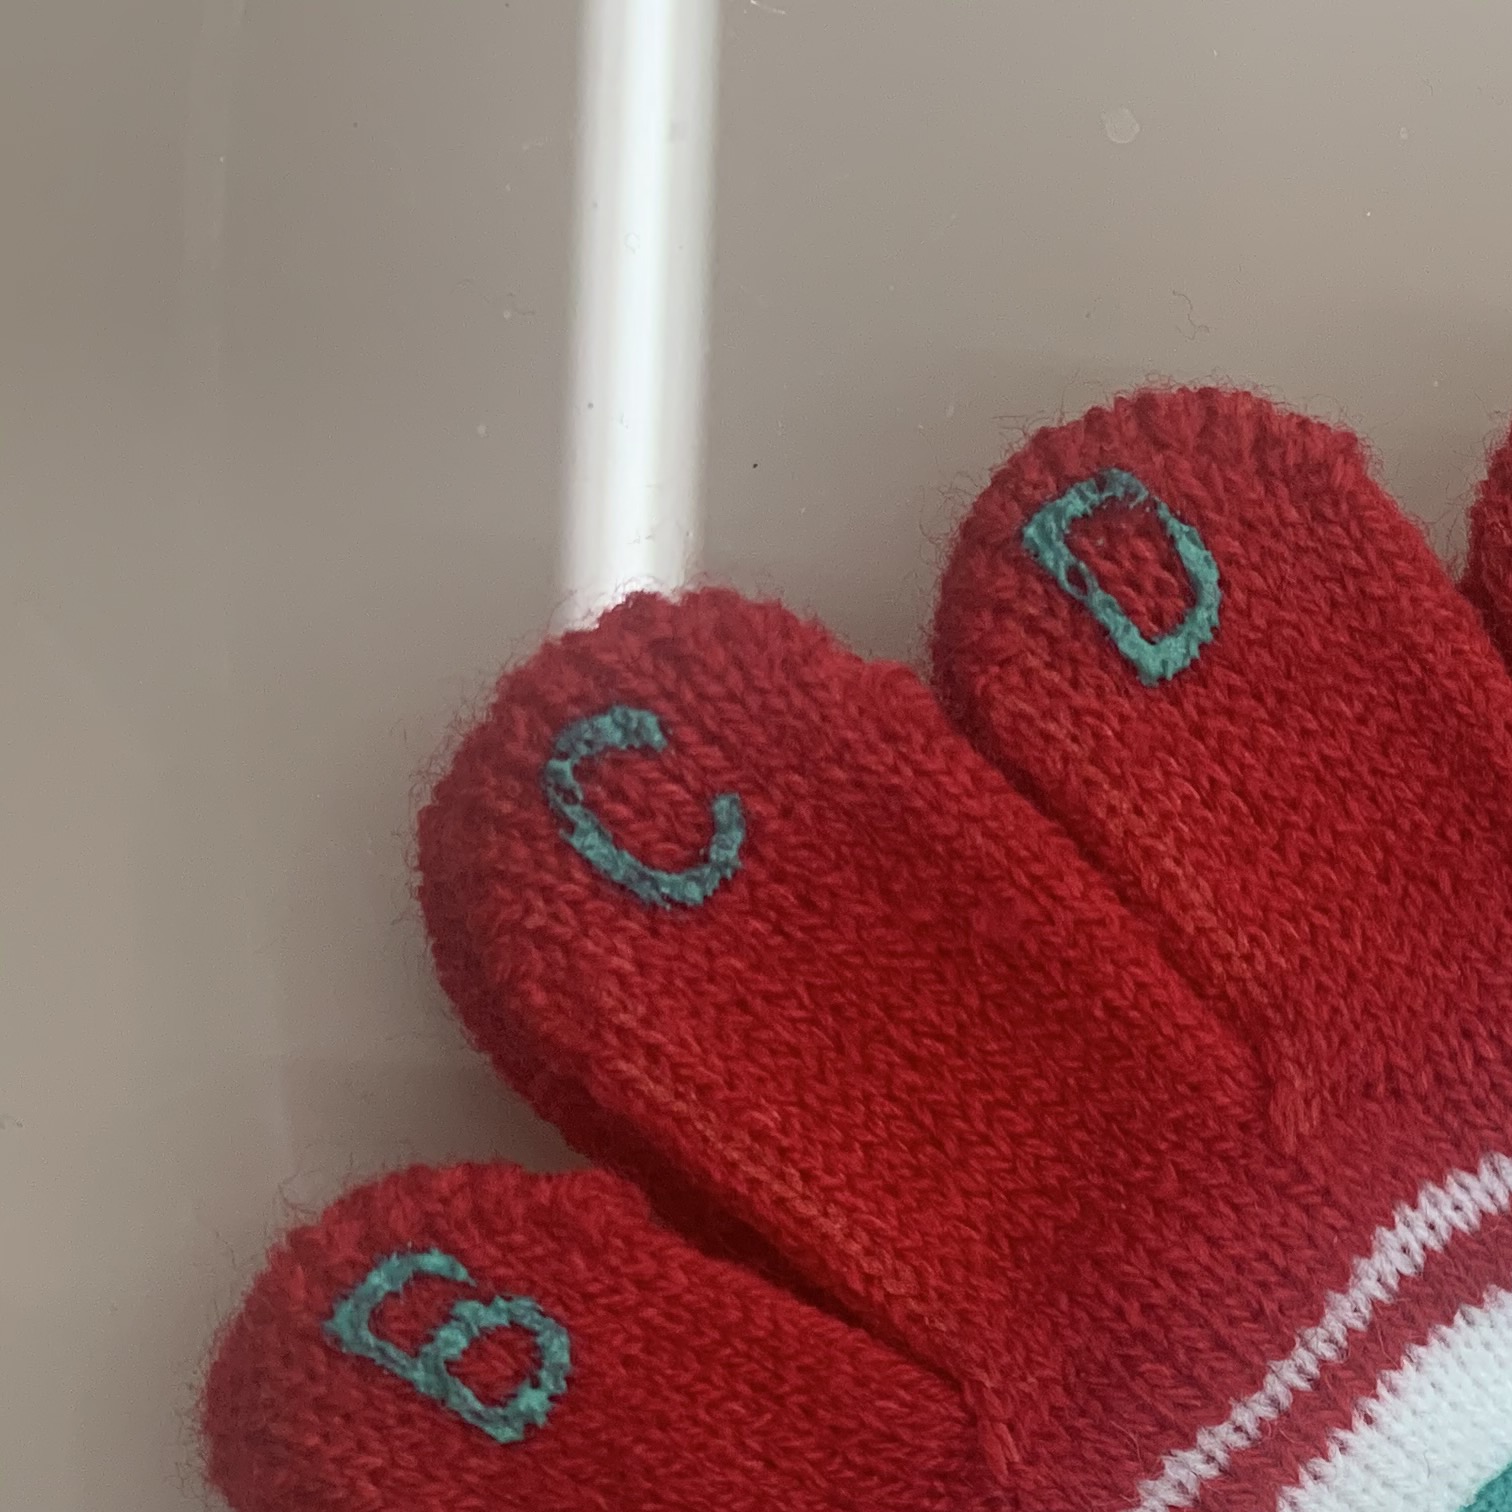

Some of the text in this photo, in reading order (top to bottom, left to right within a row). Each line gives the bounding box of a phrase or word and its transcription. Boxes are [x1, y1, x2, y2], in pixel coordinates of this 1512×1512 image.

[1022, 469, 1221, 682] D
[546, 707, 745, 906] C
[325, 1251, 573, 1443] B
